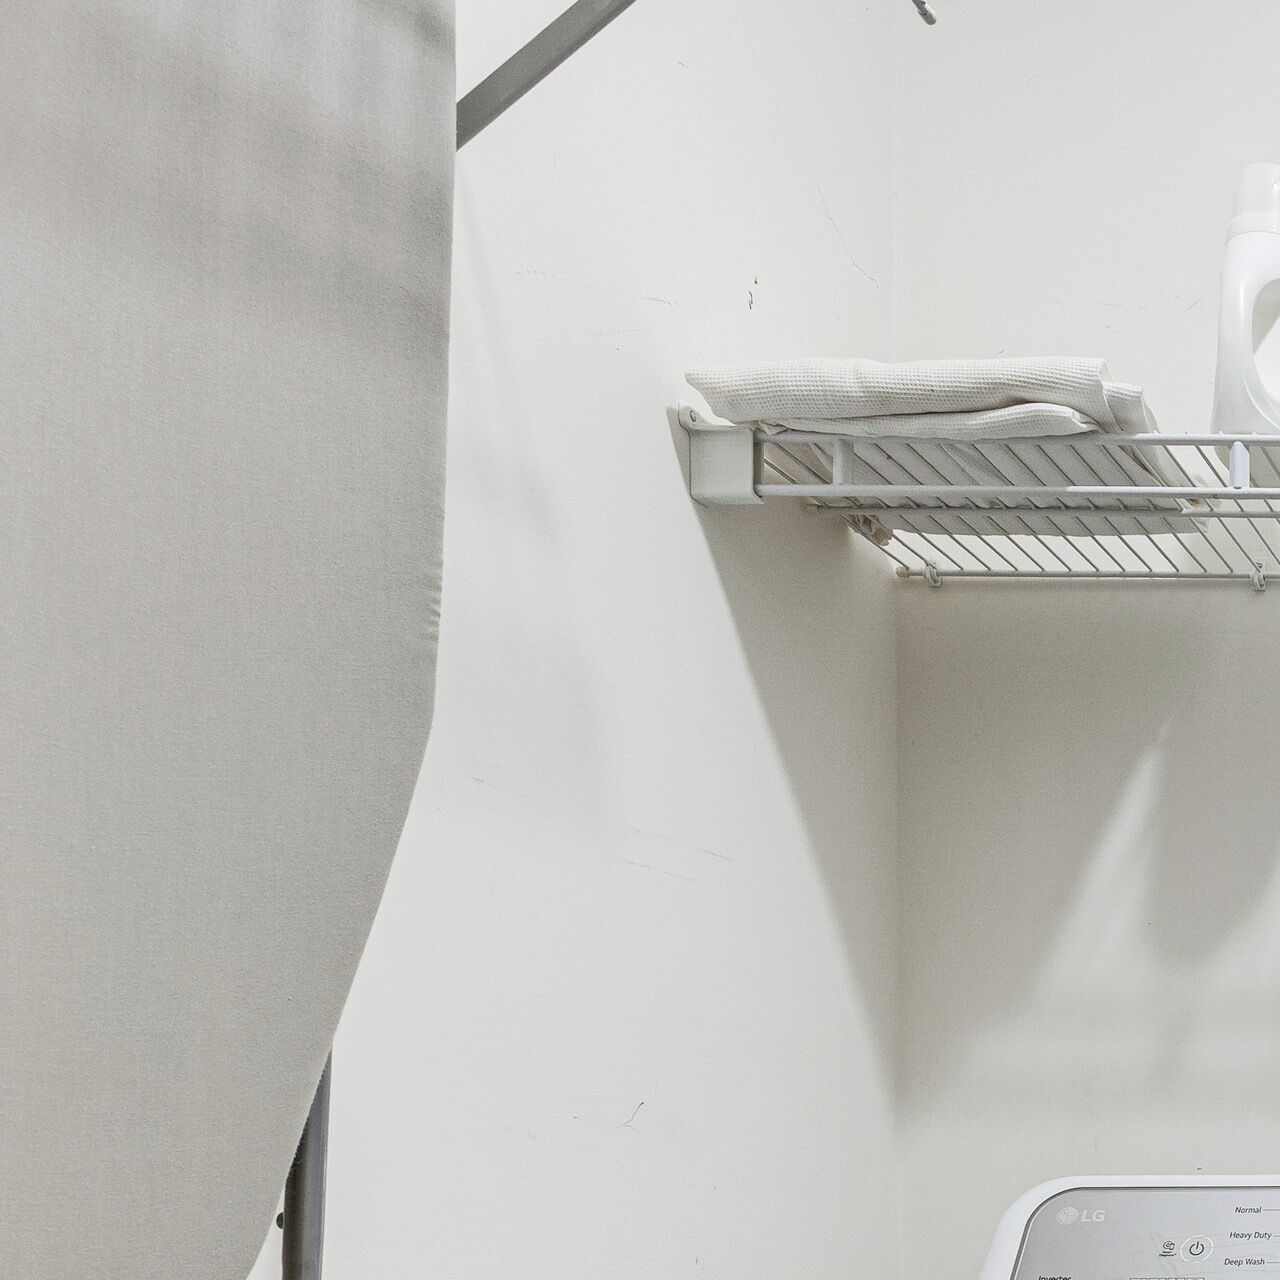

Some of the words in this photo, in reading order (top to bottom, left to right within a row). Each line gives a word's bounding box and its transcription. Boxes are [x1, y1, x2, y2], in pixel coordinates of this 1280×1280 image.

[1082, 1210, 1106, 1222] LG
[1230, 1232, 1251, 1240] Heavy
[1254, 1232, 1272, 1240] Duty
